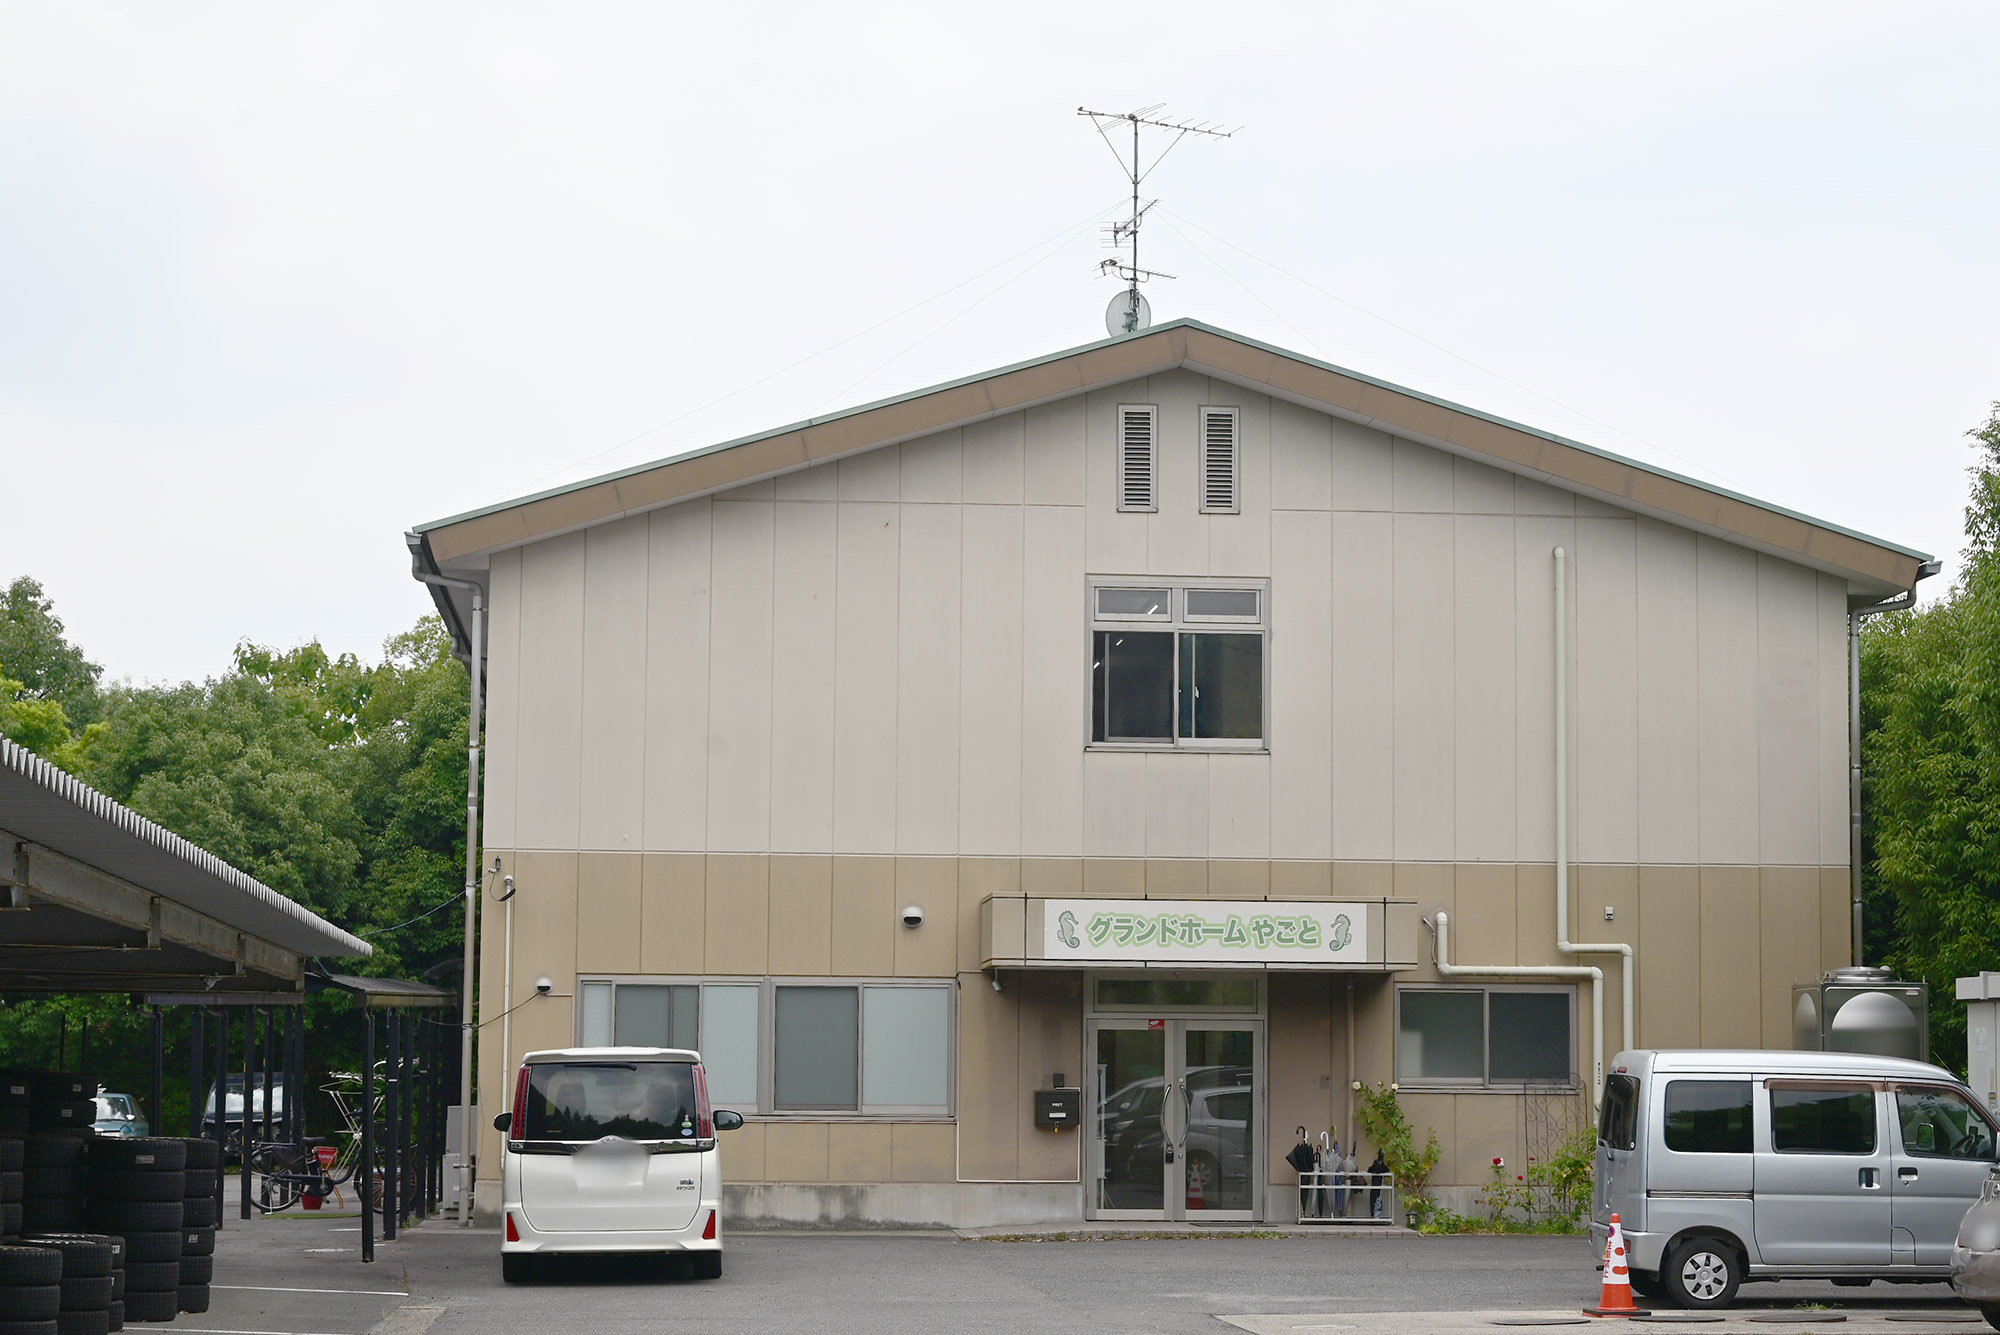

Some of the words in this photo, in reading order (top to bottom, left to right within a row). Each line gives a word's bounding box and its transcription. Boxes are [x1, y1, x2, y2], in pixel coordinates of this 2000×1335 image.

[1088, 915, 1319, 946] グランドホームやごと
